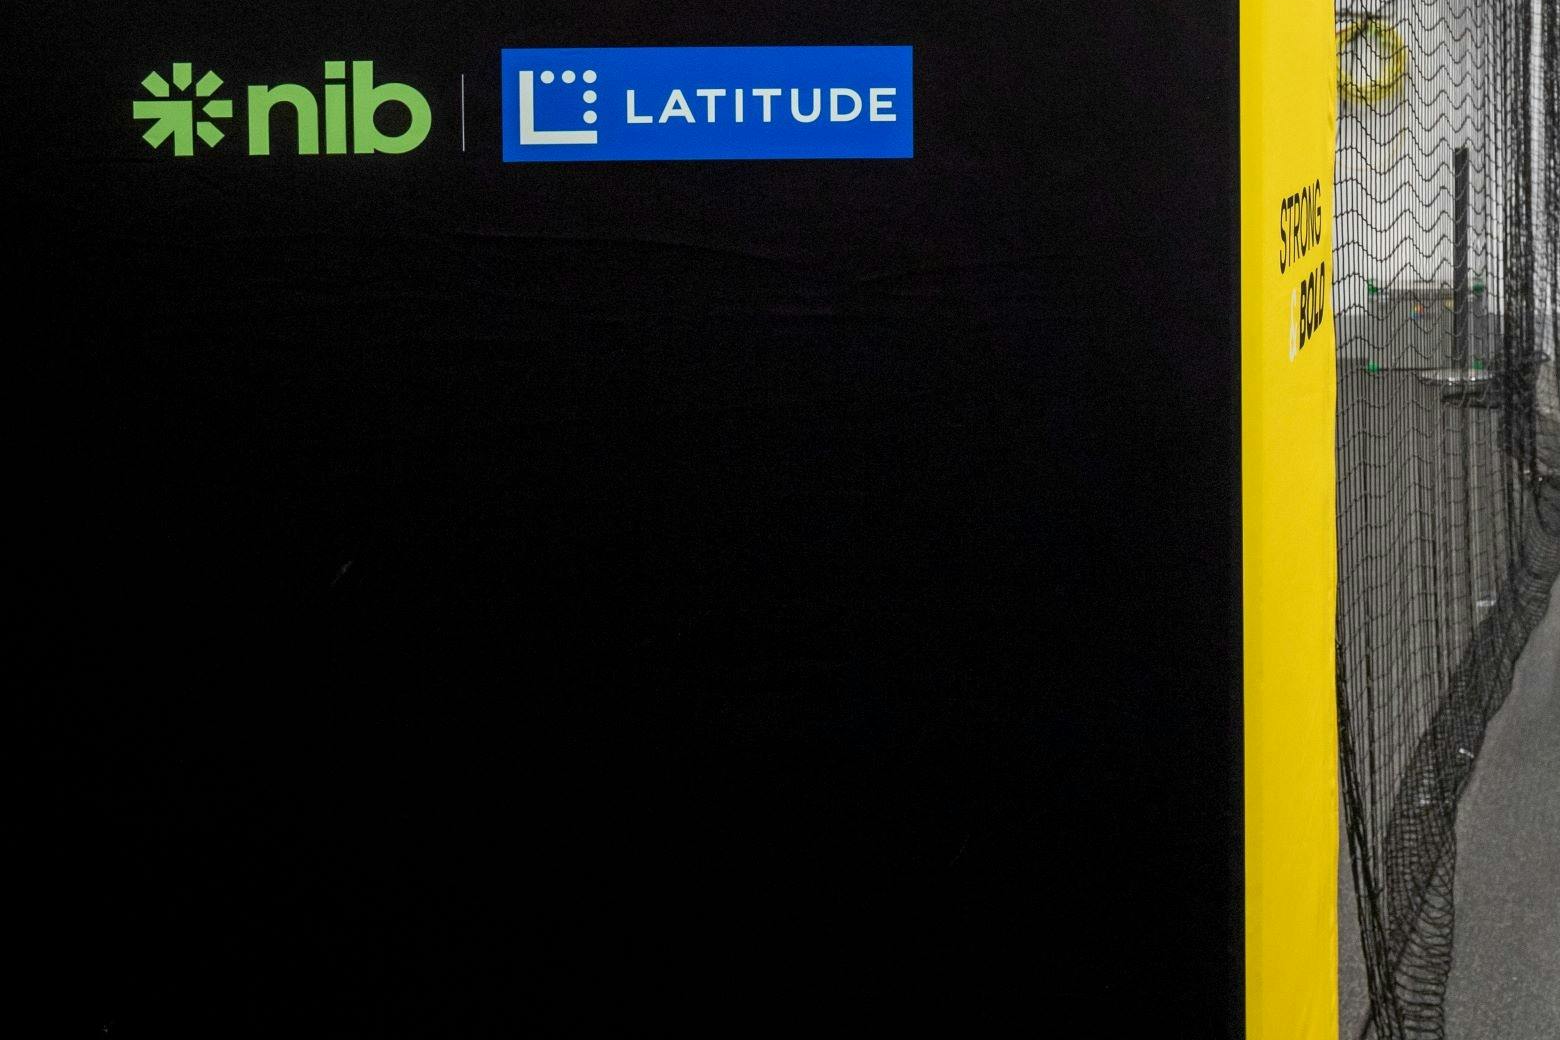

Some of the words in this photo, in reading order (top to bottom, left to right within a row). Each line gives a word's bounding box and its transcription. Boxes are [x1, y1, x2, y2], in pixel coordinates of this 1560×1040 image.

[248, 60, 432, 157] nib
[627, 87, 897, 124] LATITUDE
[1280, 179, 1322, 274] STRONG
[1300, 261, 1325, 350] BOLD
